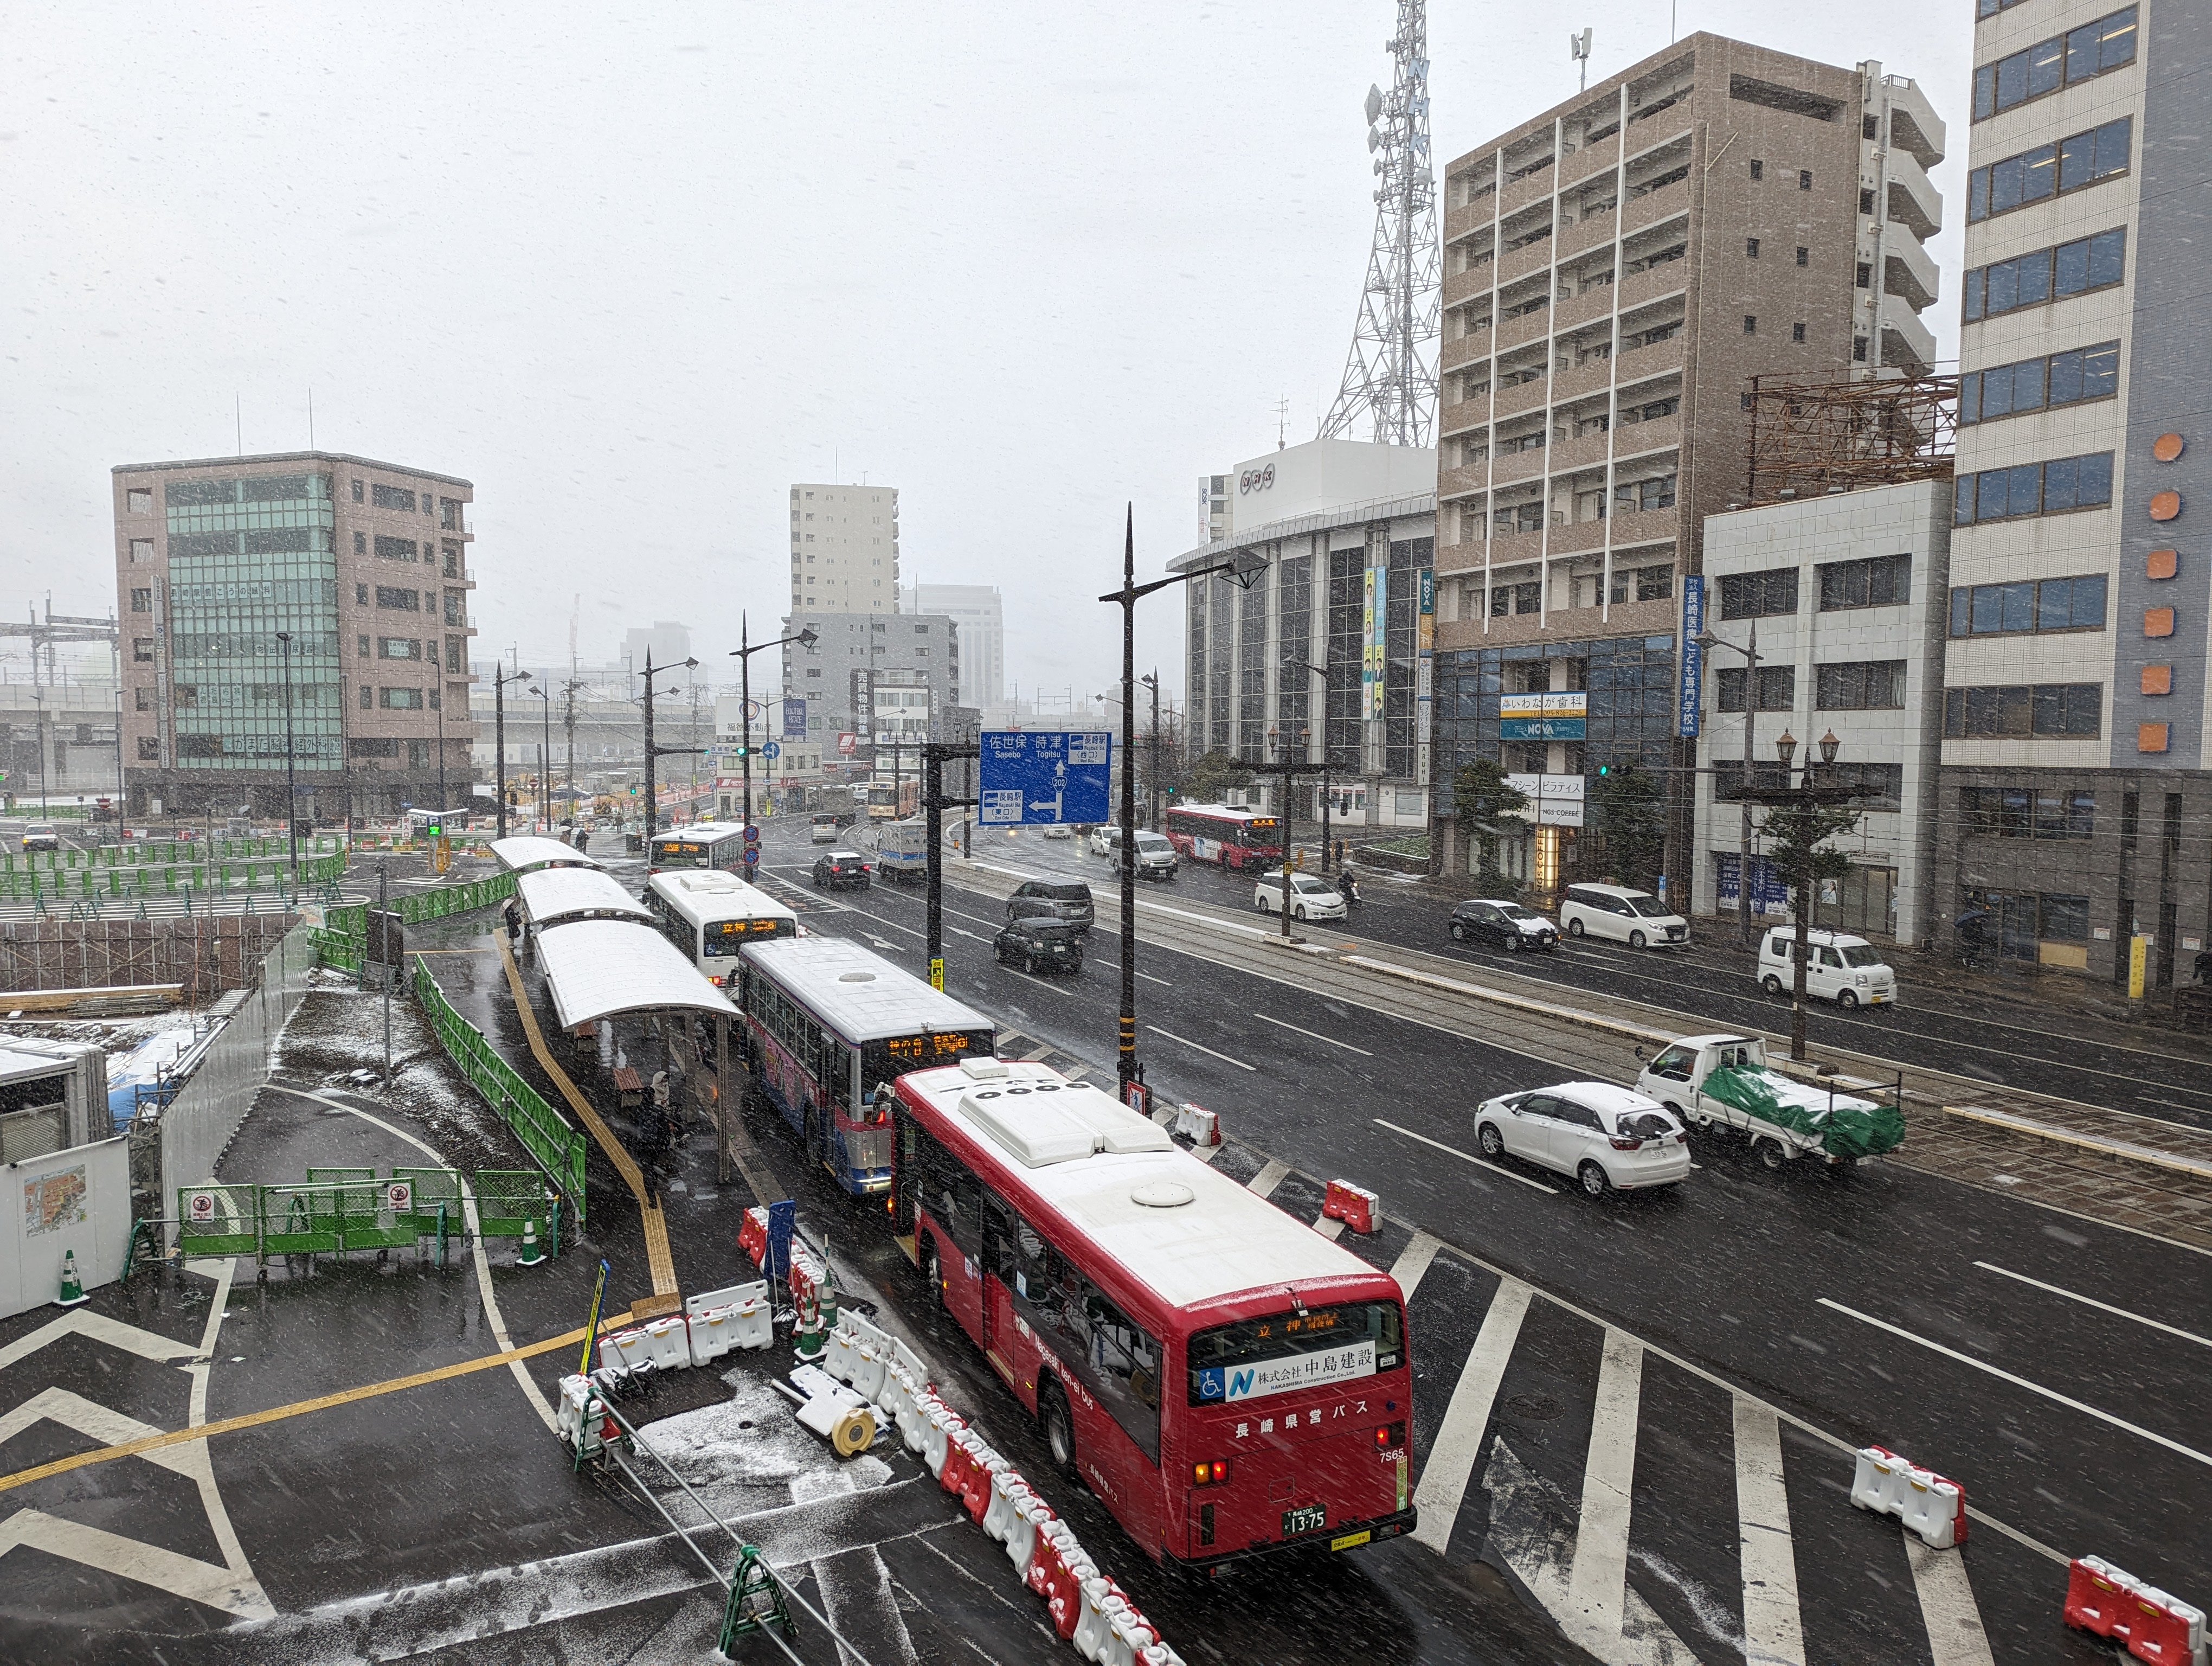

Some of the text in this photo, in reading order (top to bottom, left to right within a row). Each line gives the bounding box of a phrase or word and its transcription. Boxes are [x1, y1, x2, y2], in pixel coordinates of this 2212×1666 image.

[1242, 470, 1272, 488] NHK
[1420, 617, 1432, 646] 歯科
[857, 672, 868, 735] 売買物件募集
[1512, 695, 1583, 709] いわなが歯科
[786, 707, 805, 715] FUKUTOKU
[788, 715, 802, 723] ESTATE
[727, 723, 773, 732] 福徳不動産
[1528, 723, 1554, 735] NOVA
[989, 735, 1062, 749] 佐世保 時津
[1084, 735, 1105, 745] 長崎駅
[1037, 751, 1061, 759] Togitsu
[1511, 780, 1580, 793] マシーン ピラティス
[999, 793, 1021, 801] 長崎駅
[429, 817, 439, 825] P
[722, 922, 746, 932] 立神
[1034, 1333, 1094, 1410] Nagasaki ken-ei bus
[1257, 1366, 1302, 1385] 株式会社
[1305, 1349, 1373, 1376] 中島建設
[1270, 1380, 1303, 1391] NAKASHIMA
[1304, 1374, 1336, 1383] Construction
[1235, 1400, 1368, 1439] 長崎県営バス
[1379, 1447, 1404, 1463] 7S65
[1090, 1463, 1119, 1505] 長崎県営バス
[1291, 1511, 1324, 1533] 13-75
